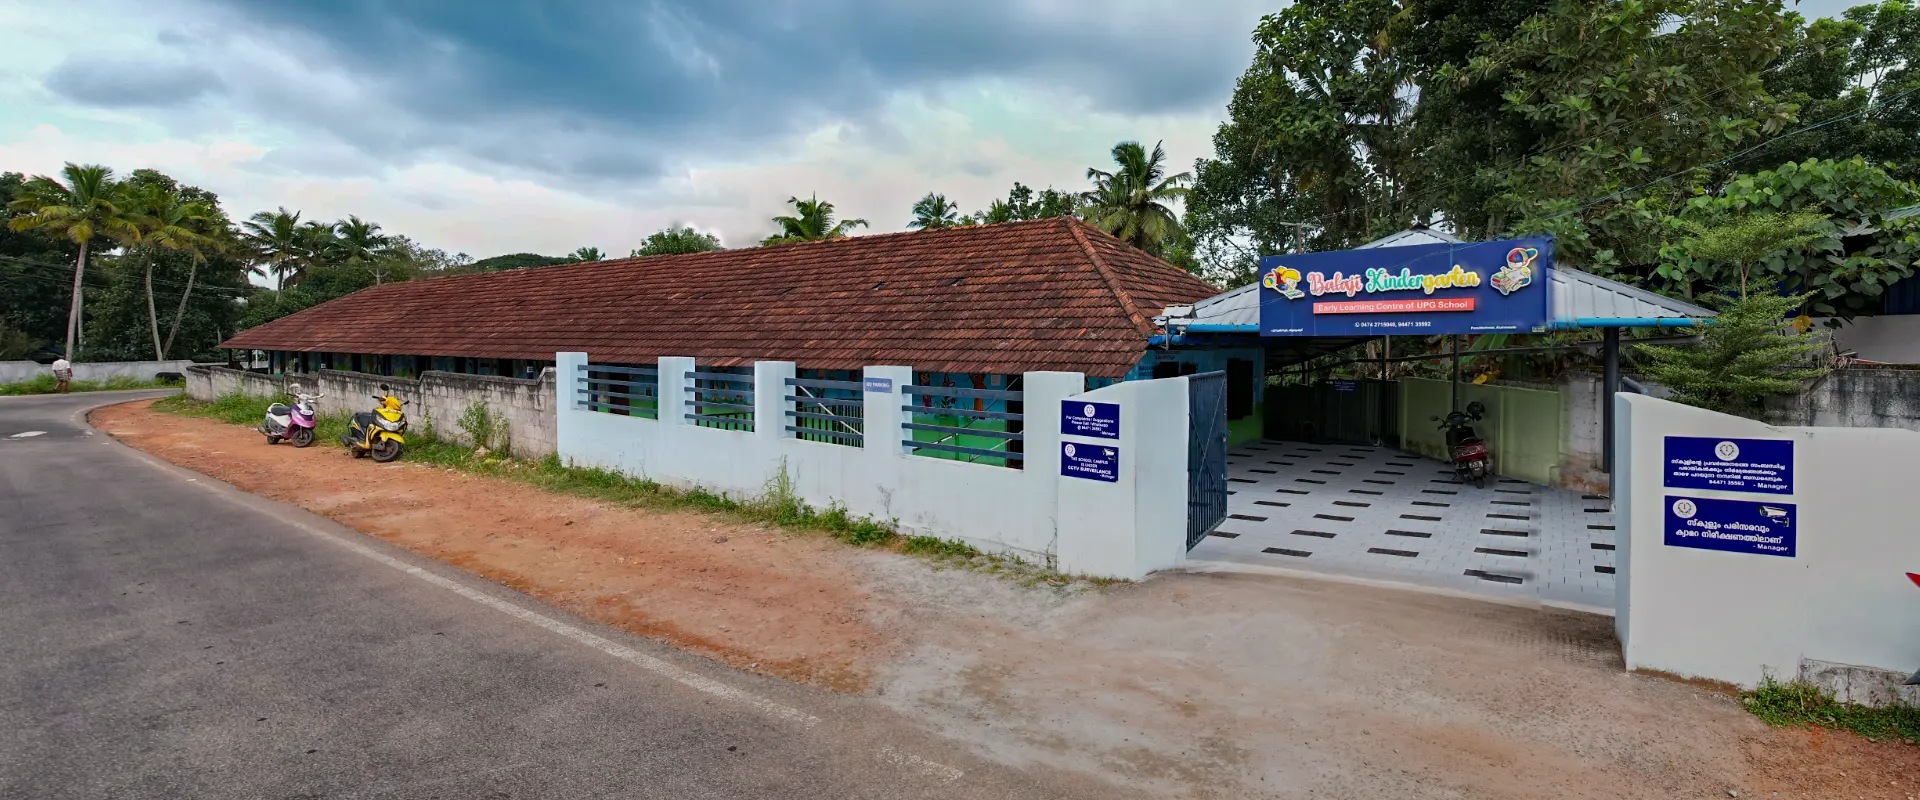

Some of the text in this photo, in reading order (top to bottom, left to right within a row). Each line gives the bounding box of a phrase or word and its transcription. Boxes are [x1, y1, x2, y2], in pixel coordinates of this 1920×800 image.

[1307, 265, 1479, 296] Balaji Kindergarten
[1318, 304, 1338, 313] Early
[1340, 304, 1374, 312] Learning
[1406, 301, 1414, 309] of
[1416, 301, 1436, 309] UPG
[1438, 301, 1468, 309] School
[1757, 482, 1788, 490] Manager
[1757, 543, 1788, 552] Manager
